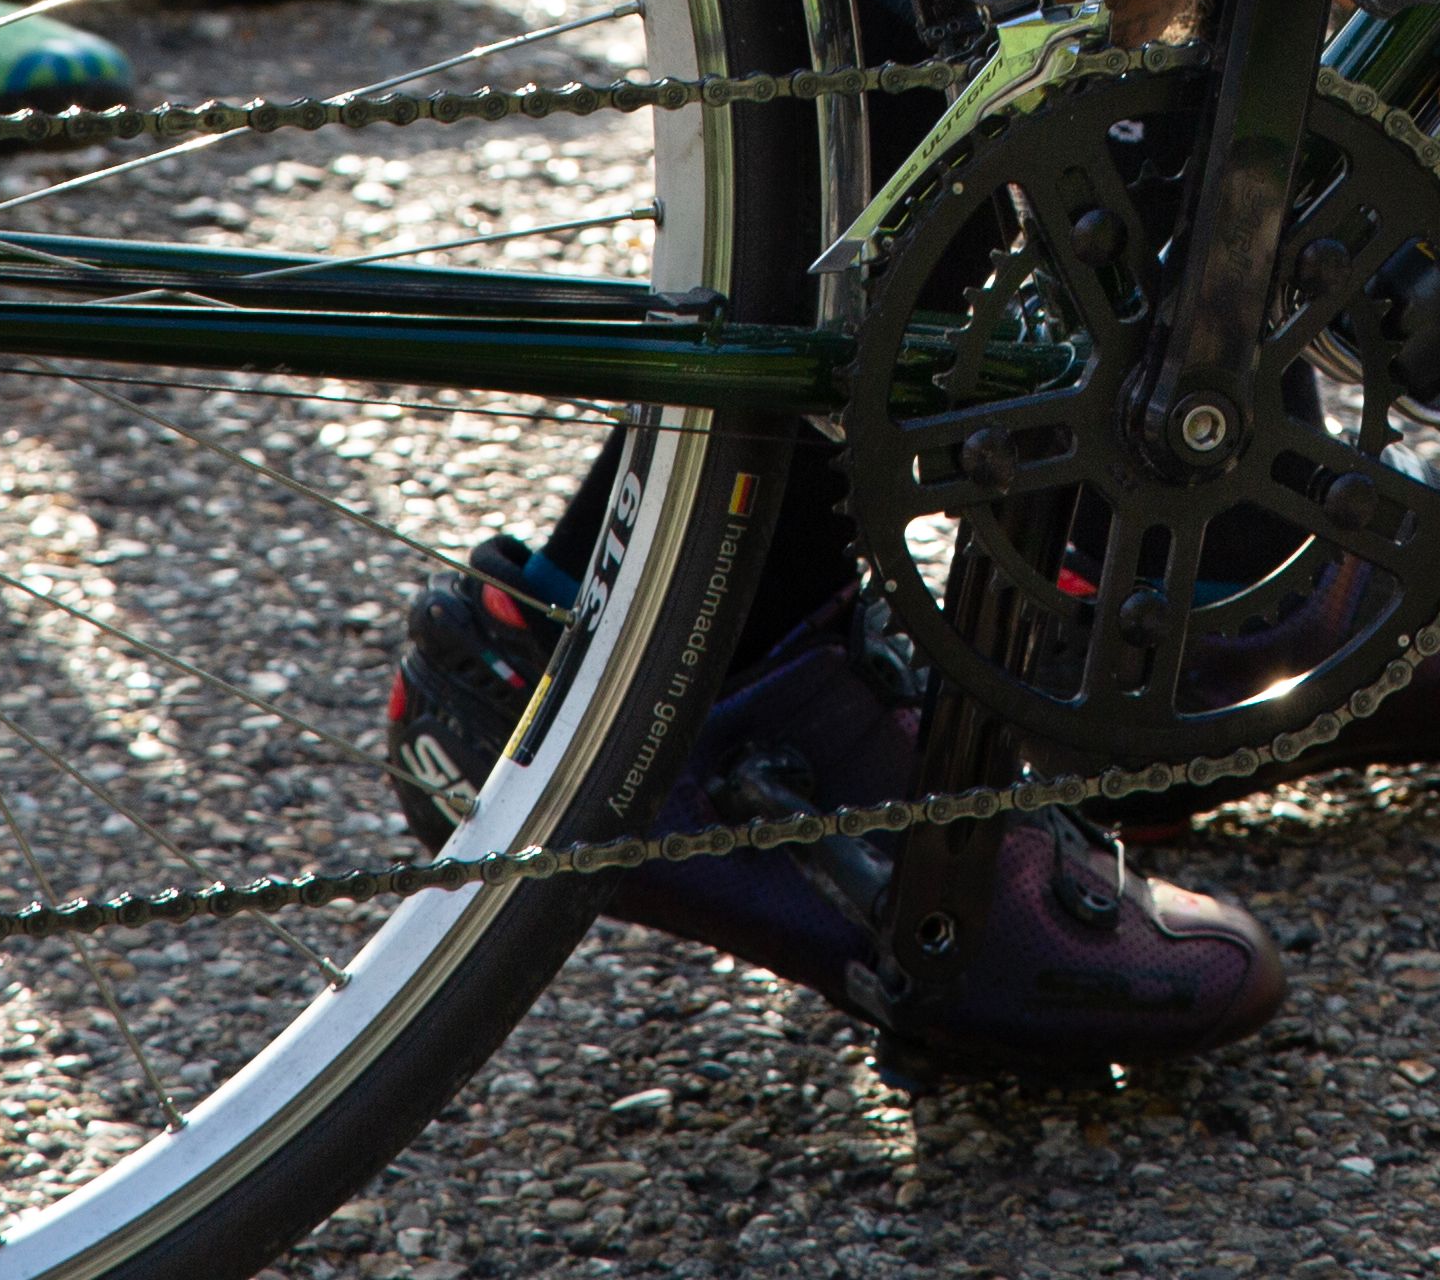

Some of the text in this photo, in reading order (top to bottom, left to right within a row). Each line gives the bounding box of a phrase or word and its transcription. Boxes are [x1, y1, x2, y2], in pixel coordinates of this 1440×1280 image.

[580, 471, 642, 632] 319
[607, 523, 748, 820] handmade in germany
